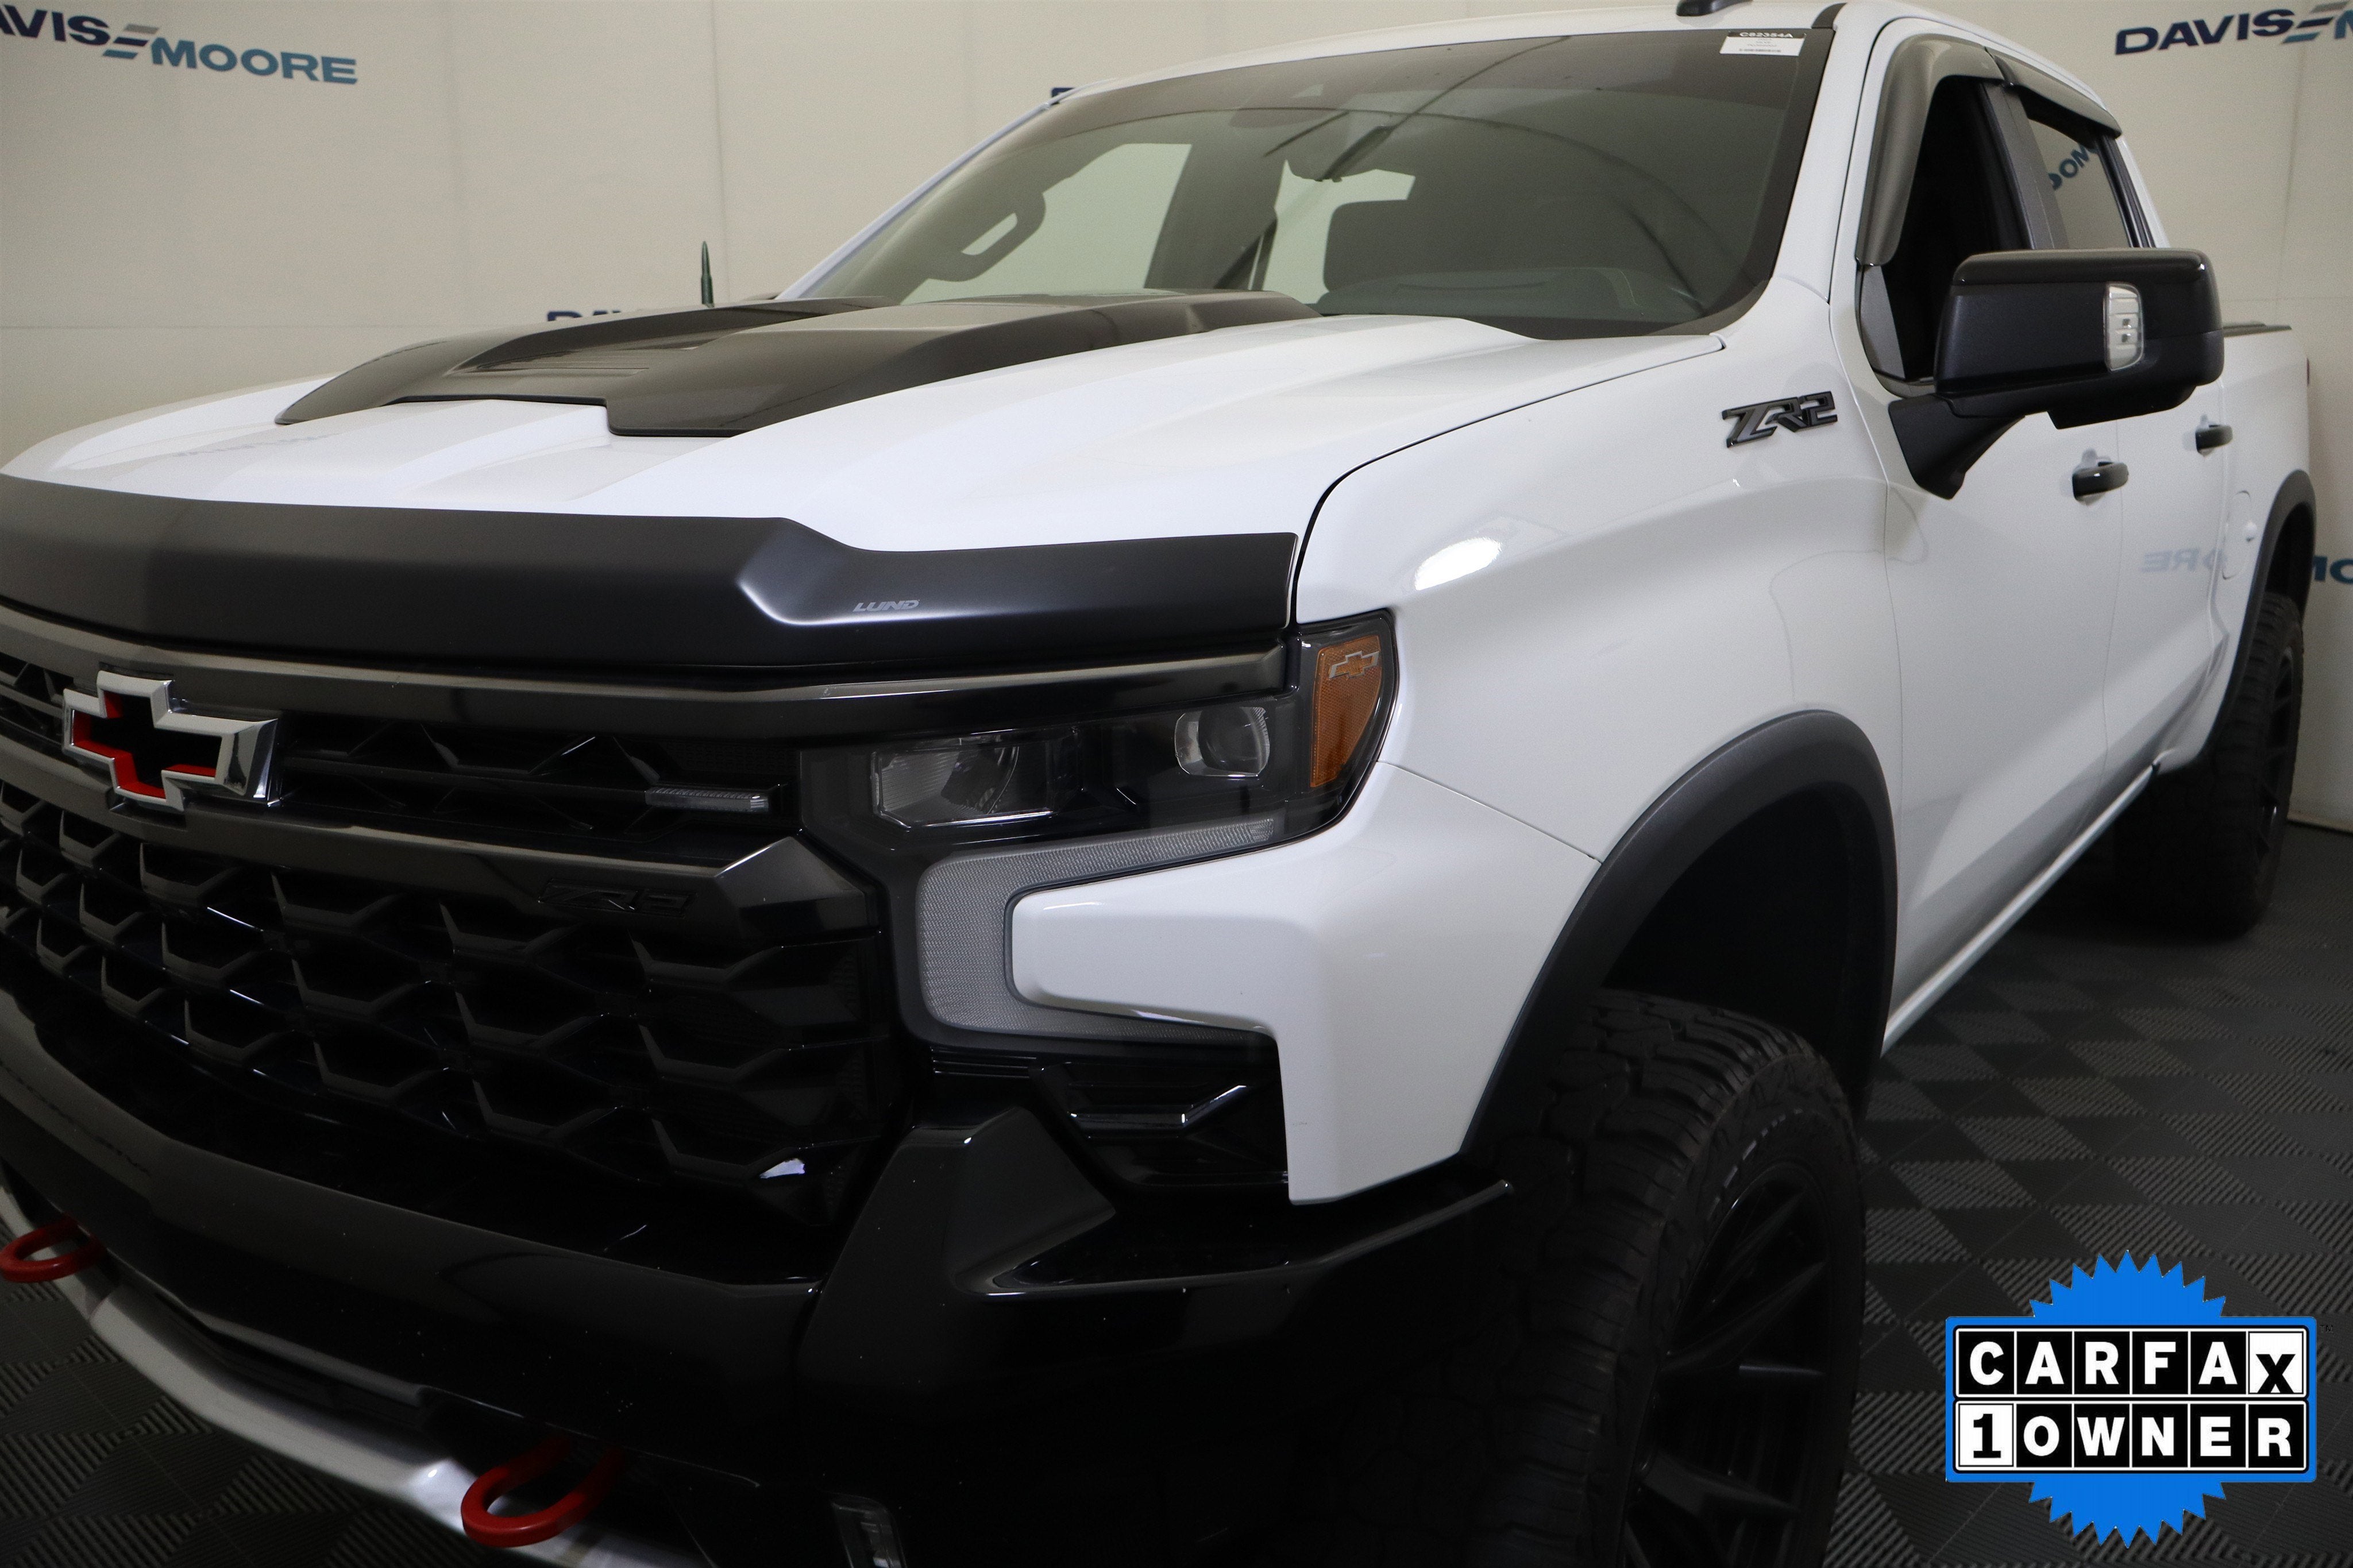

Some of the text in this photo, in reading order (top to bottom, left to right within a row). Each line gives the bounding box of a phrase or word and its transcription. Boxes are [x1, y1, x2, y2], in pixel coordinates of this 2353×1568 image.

[2115, 9, 2294, 55] DAVIS
[151, 37, 357, 84] MOORE
[1722, 391, 1838, 448] ZR2
[853, 600, 919, 612] LUND
